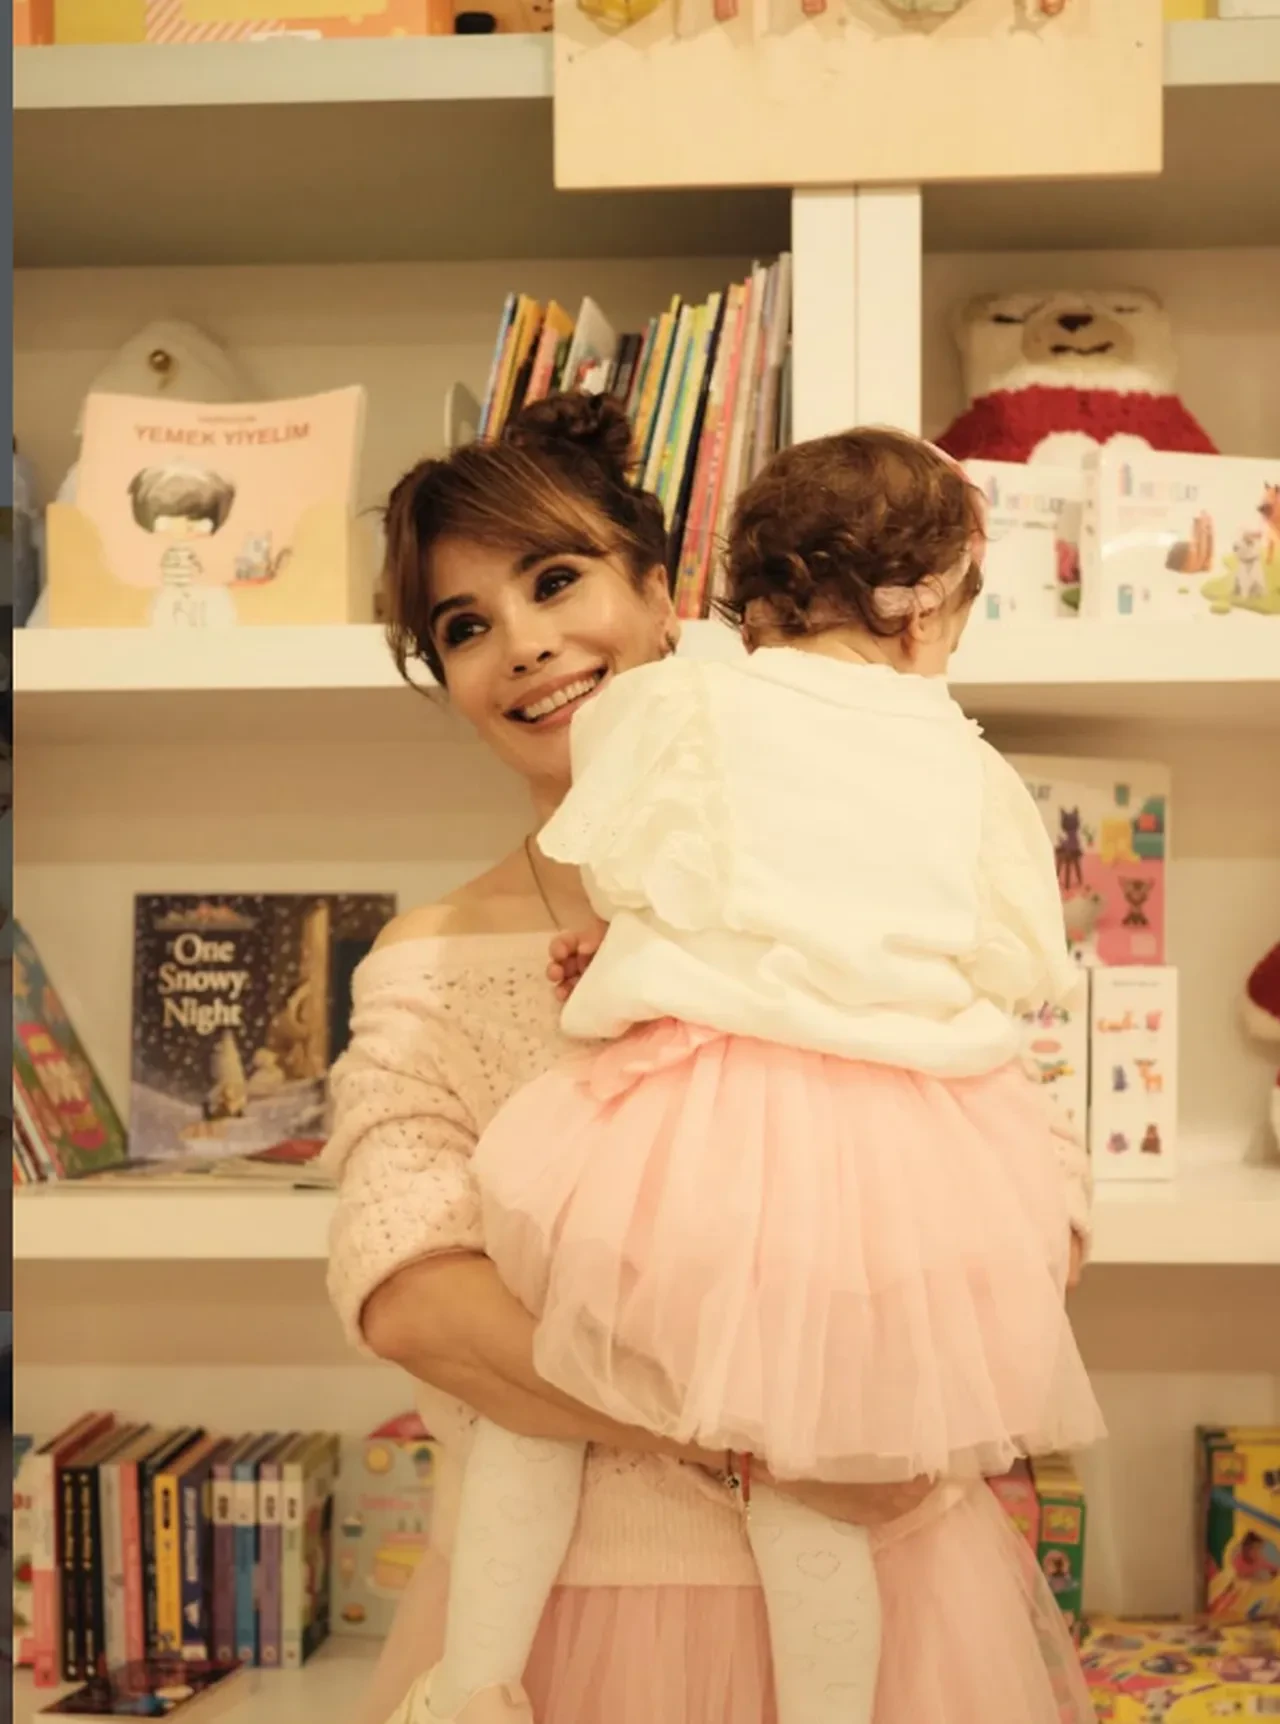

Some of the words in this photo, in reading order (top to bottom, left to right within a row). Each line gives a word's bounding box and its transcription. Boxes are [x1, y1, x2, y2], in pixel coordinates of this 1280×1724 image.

[134, 424, 216, 446] YEMEK
[172, 932, 235, 965] One
[158, 962, 249, 1000] Snowy
[163, 997, 243, 1035] Night
